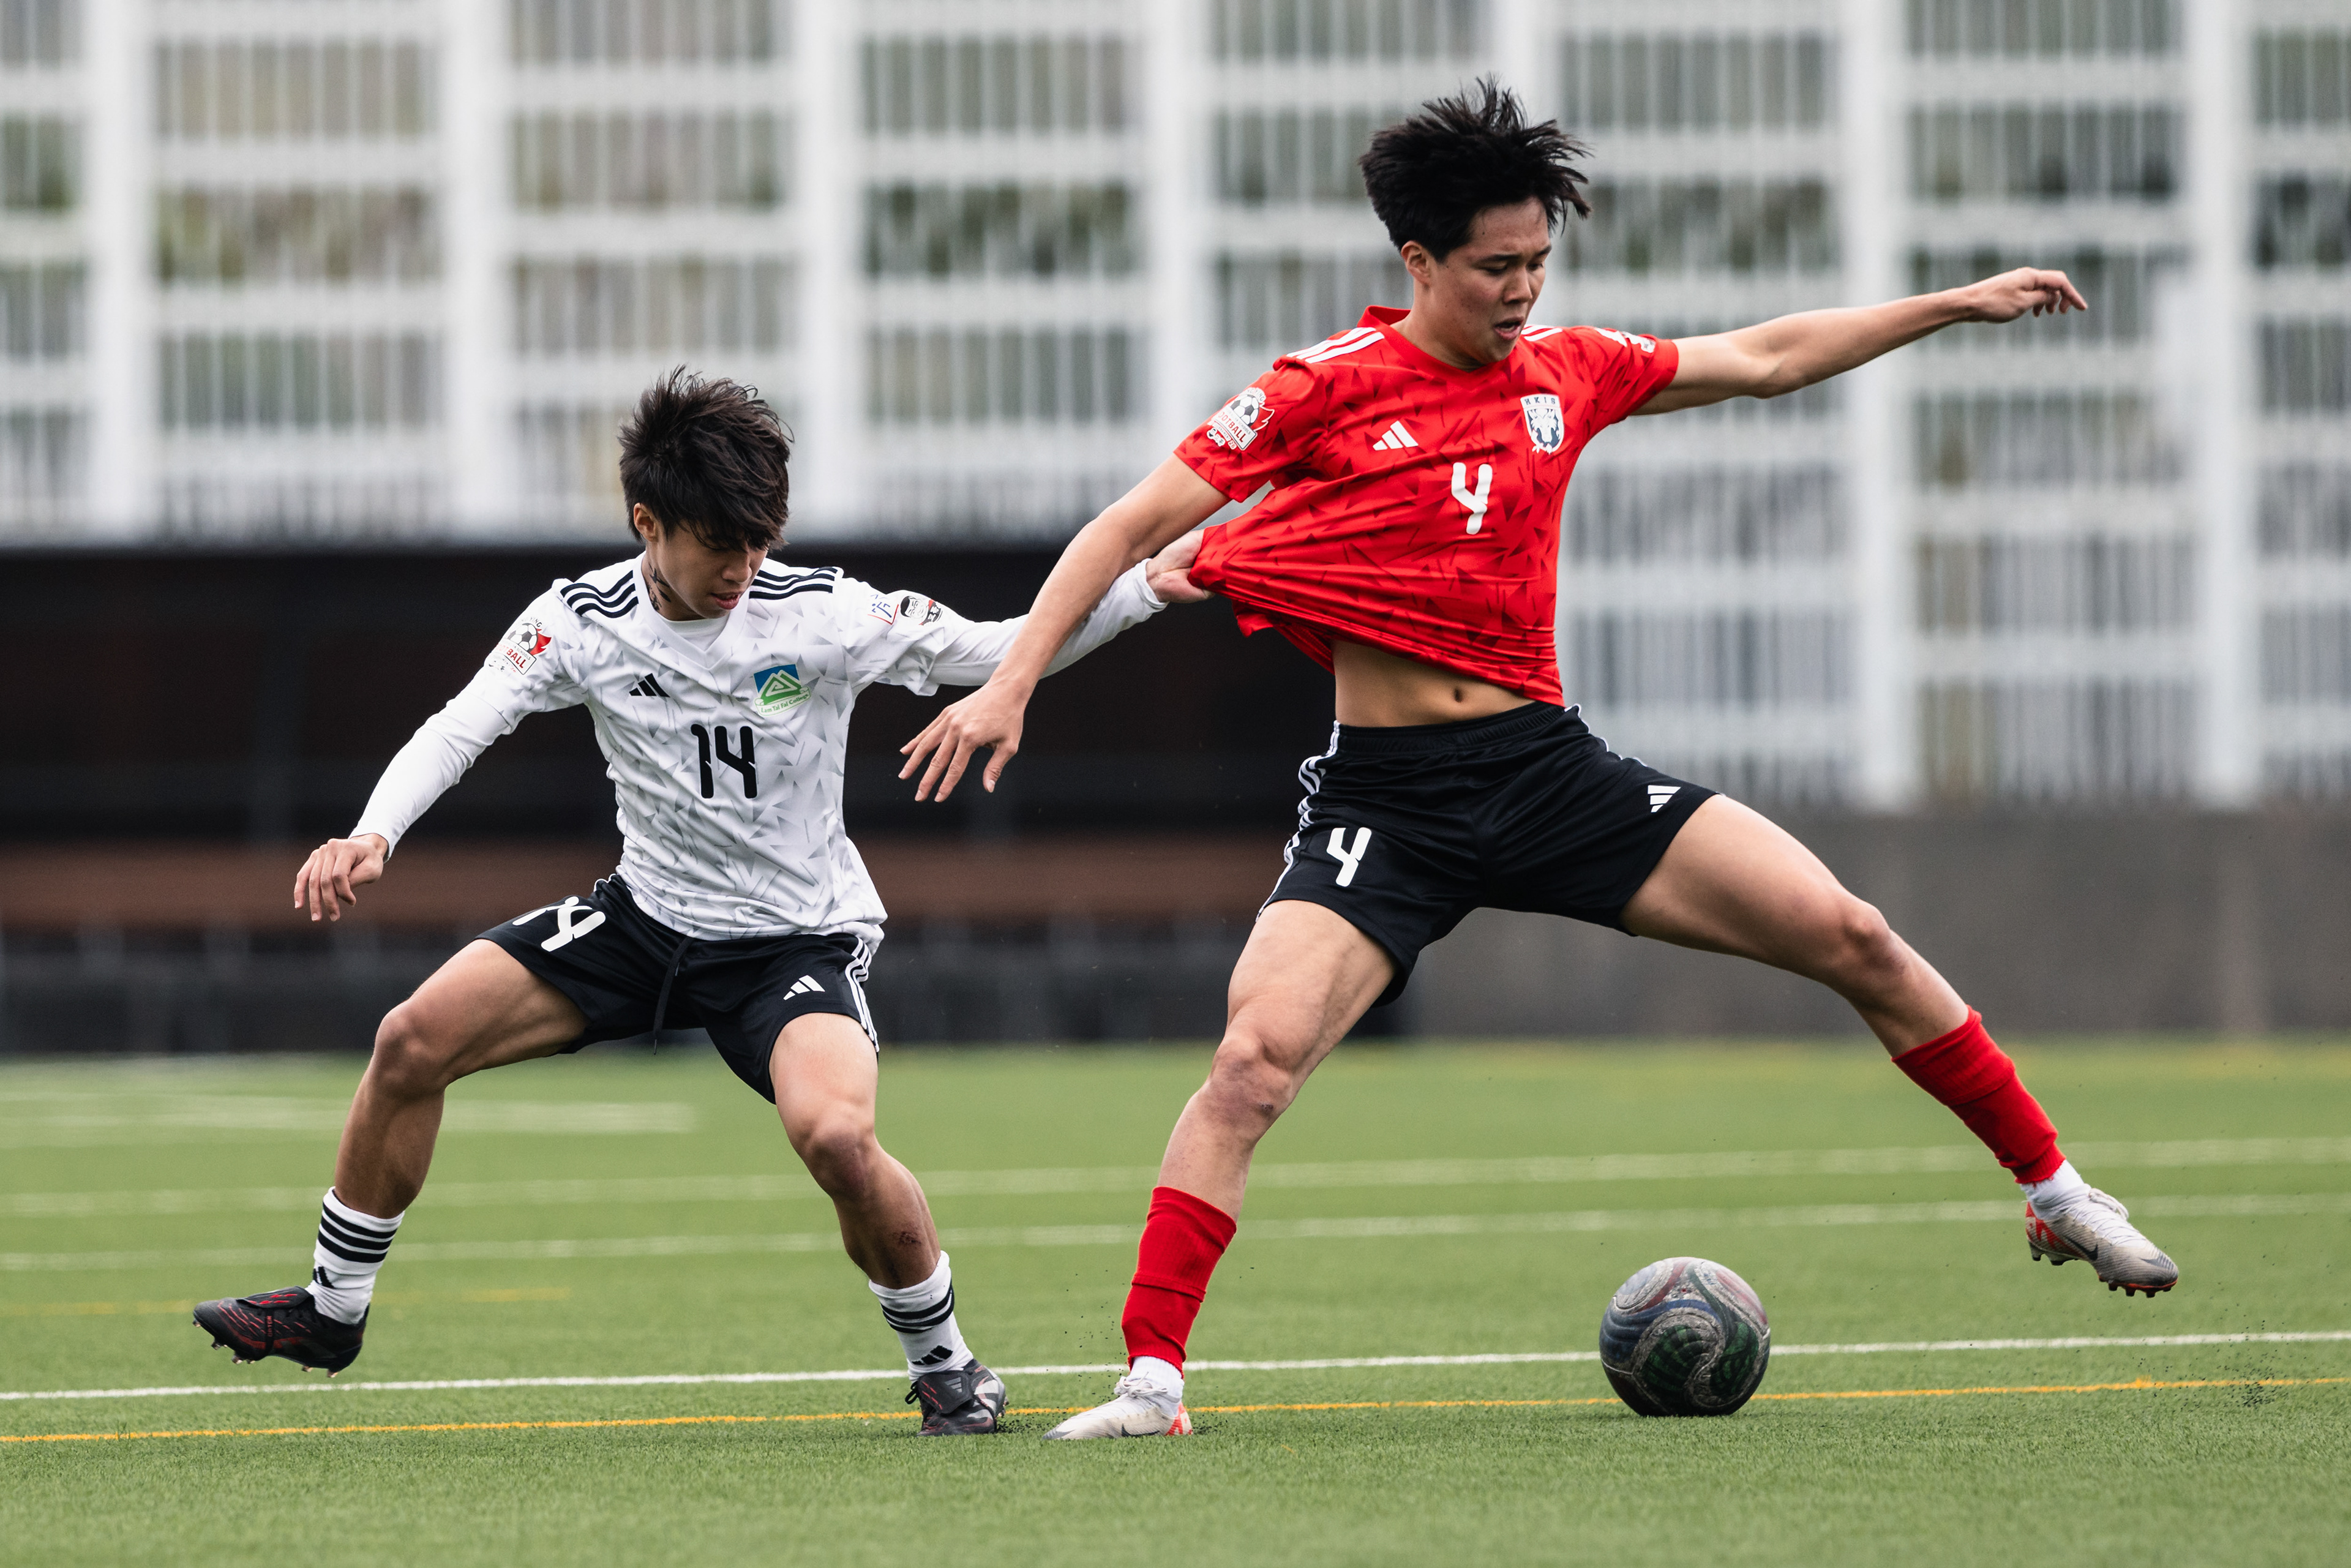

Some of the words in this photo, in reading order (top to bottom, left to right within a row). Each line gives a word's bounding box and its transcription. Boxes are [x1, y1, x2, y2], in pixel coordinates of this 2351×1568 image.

[1524, 396, 1556, 405] HKIS
[1218, 411, 1247, 443] OOTBALL
[1451, 462, 1493, 535] 4
[789, 694, 809, 705] College
[690, 724, 758, 799] 14
[1326, 827, 1372, 887] 4
